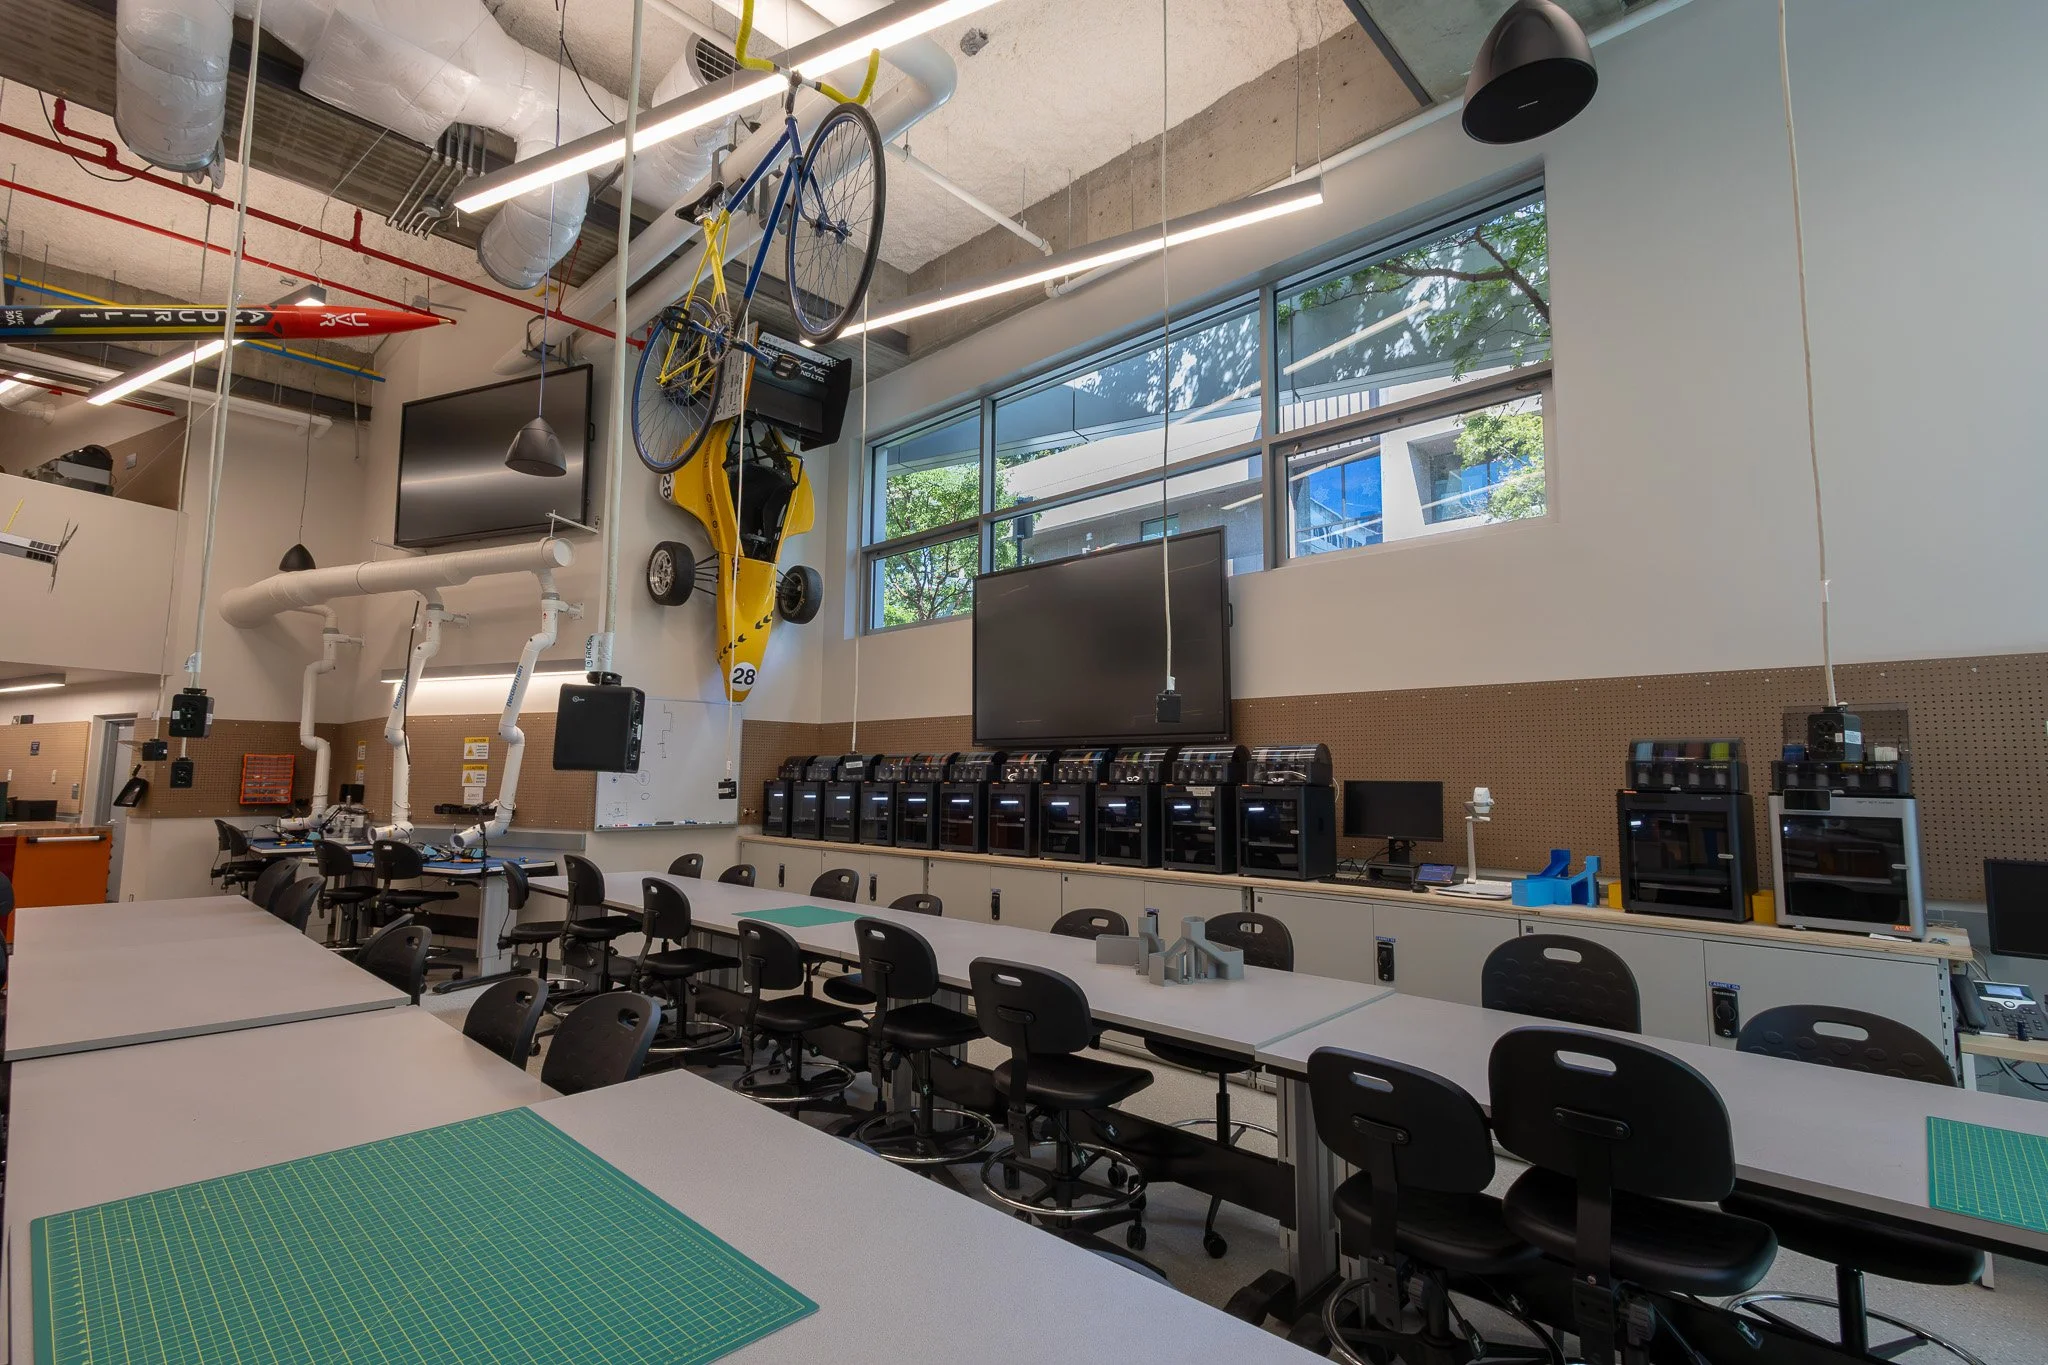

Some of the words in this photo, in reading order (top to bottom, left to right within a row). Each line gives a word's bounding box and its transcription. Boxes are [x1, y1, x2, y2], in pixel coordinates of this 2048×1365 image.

[662, 473, 672, 499] 28
[506, 665, 524, 708] Nederman
[732, 667, 756, 686] 28
